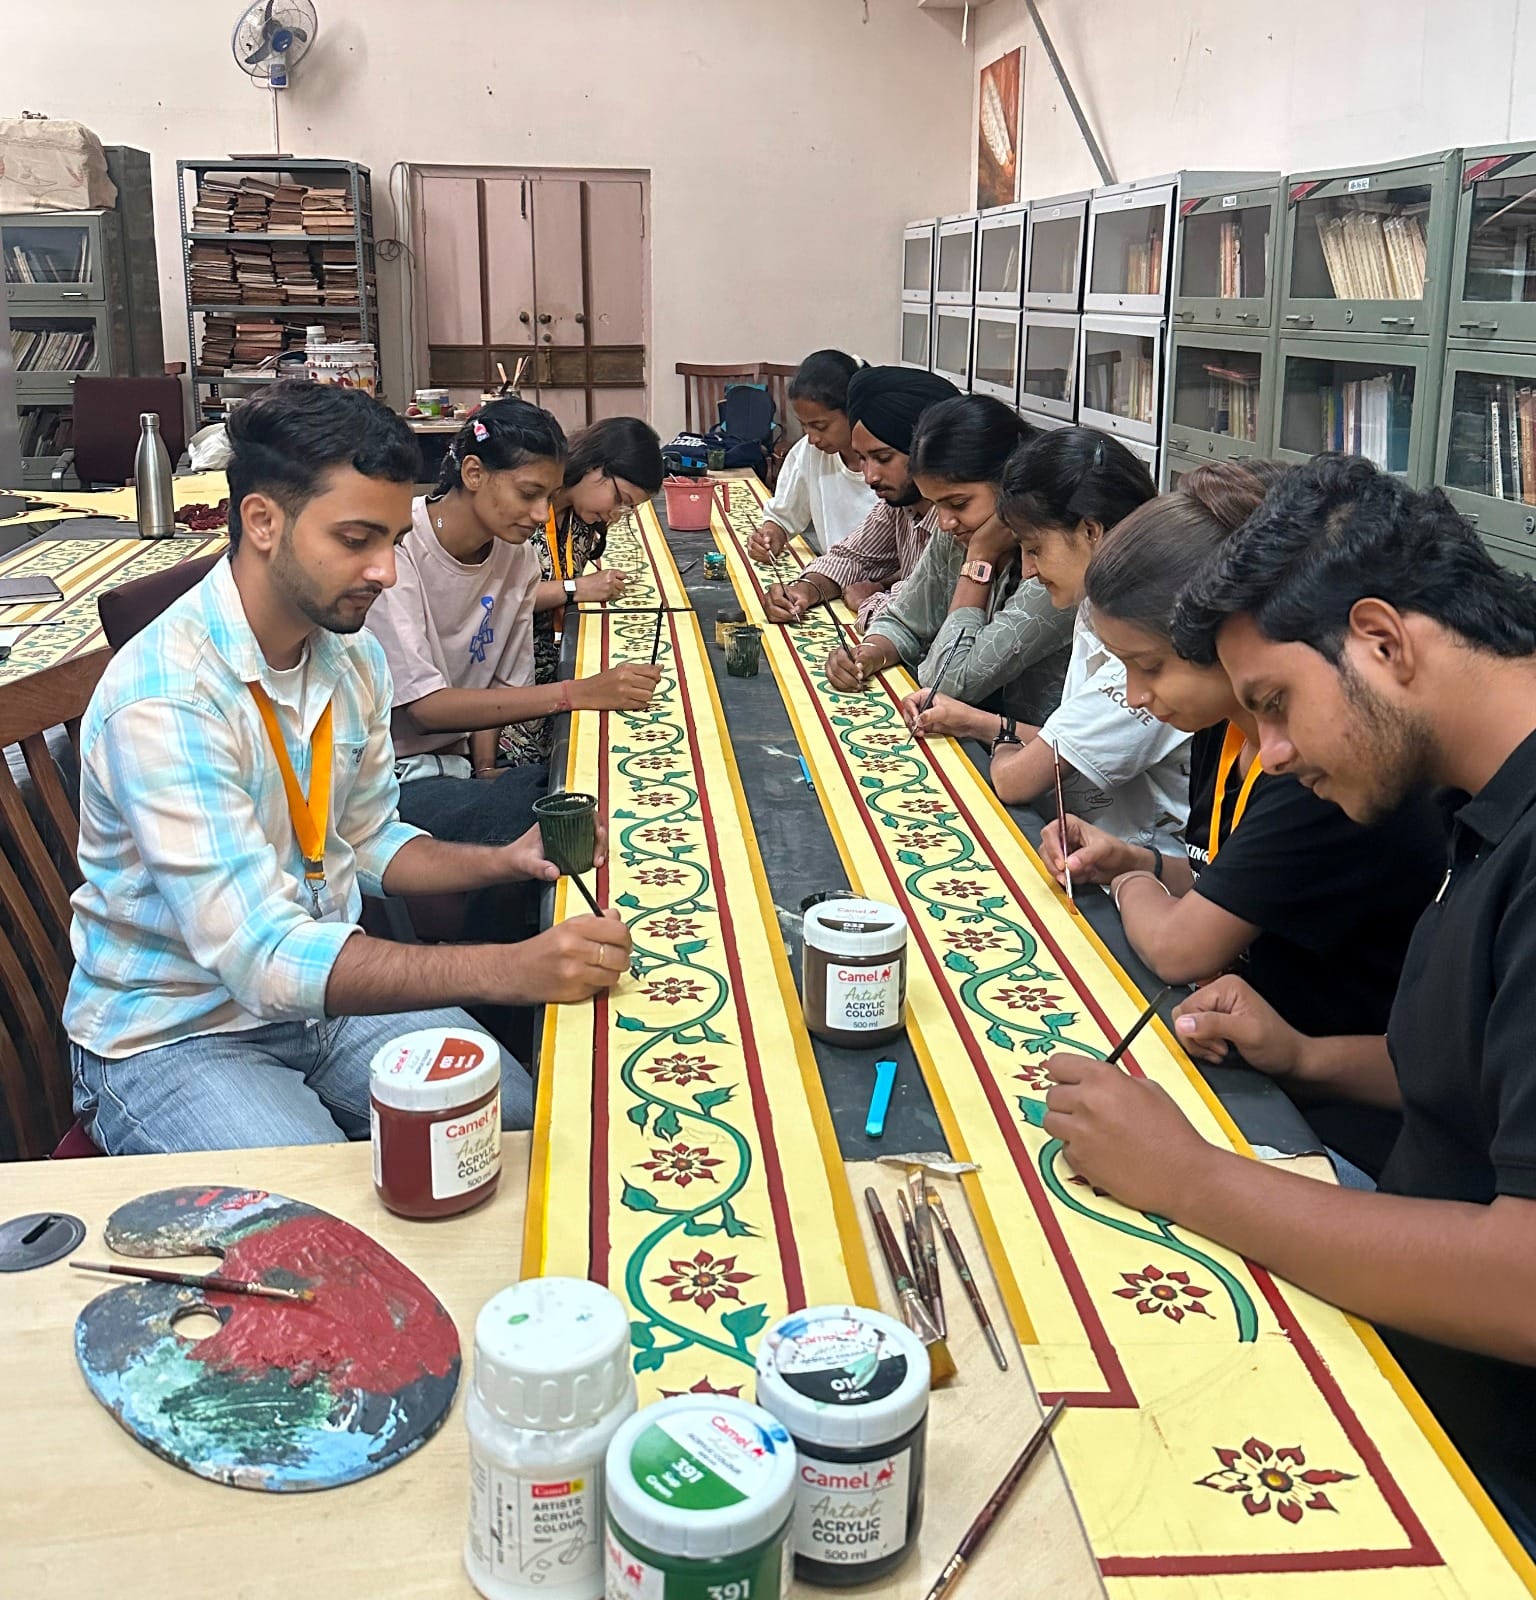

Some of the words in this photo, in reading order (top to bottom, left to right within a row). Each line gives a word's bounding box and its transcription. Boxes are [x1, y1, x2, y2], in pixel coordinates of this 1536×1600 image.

[1098, 686, 1154, 726] ACOSTE
[838, 970, 879, 983] Camel
[844, 986, 886, 1001] Artist
[845, 1000, 885, 1010] ACRYLIC
[845, 1008, 885, 1018] COLOUR
[868, 1020, 879, 1028] ml
[446, 1111, 489, 1138] Camel
[456, 1128, 495, 1159] Artist
[457, 1143, 495, 1169] ACRYLIC
[711, 1416, 754, 1448] Camel
[671, 1457, 705, 1484] 391
[801, 1465, 870, 1488] Camel
[534, 1507, 583, 1522] ACRYLIC
[809, 1495, 884, 1519] Artist
[534, 1518, 584, 1534] COLOUR
[812, 1517, 881, 1532] ACRYLIC
[812, 1530, 880, 1545] COLOUR
[824, 1549, 849, 1560] 500
[851, 1549, 867, 1560] ml
[707, 1579, 750, 1600] 391
